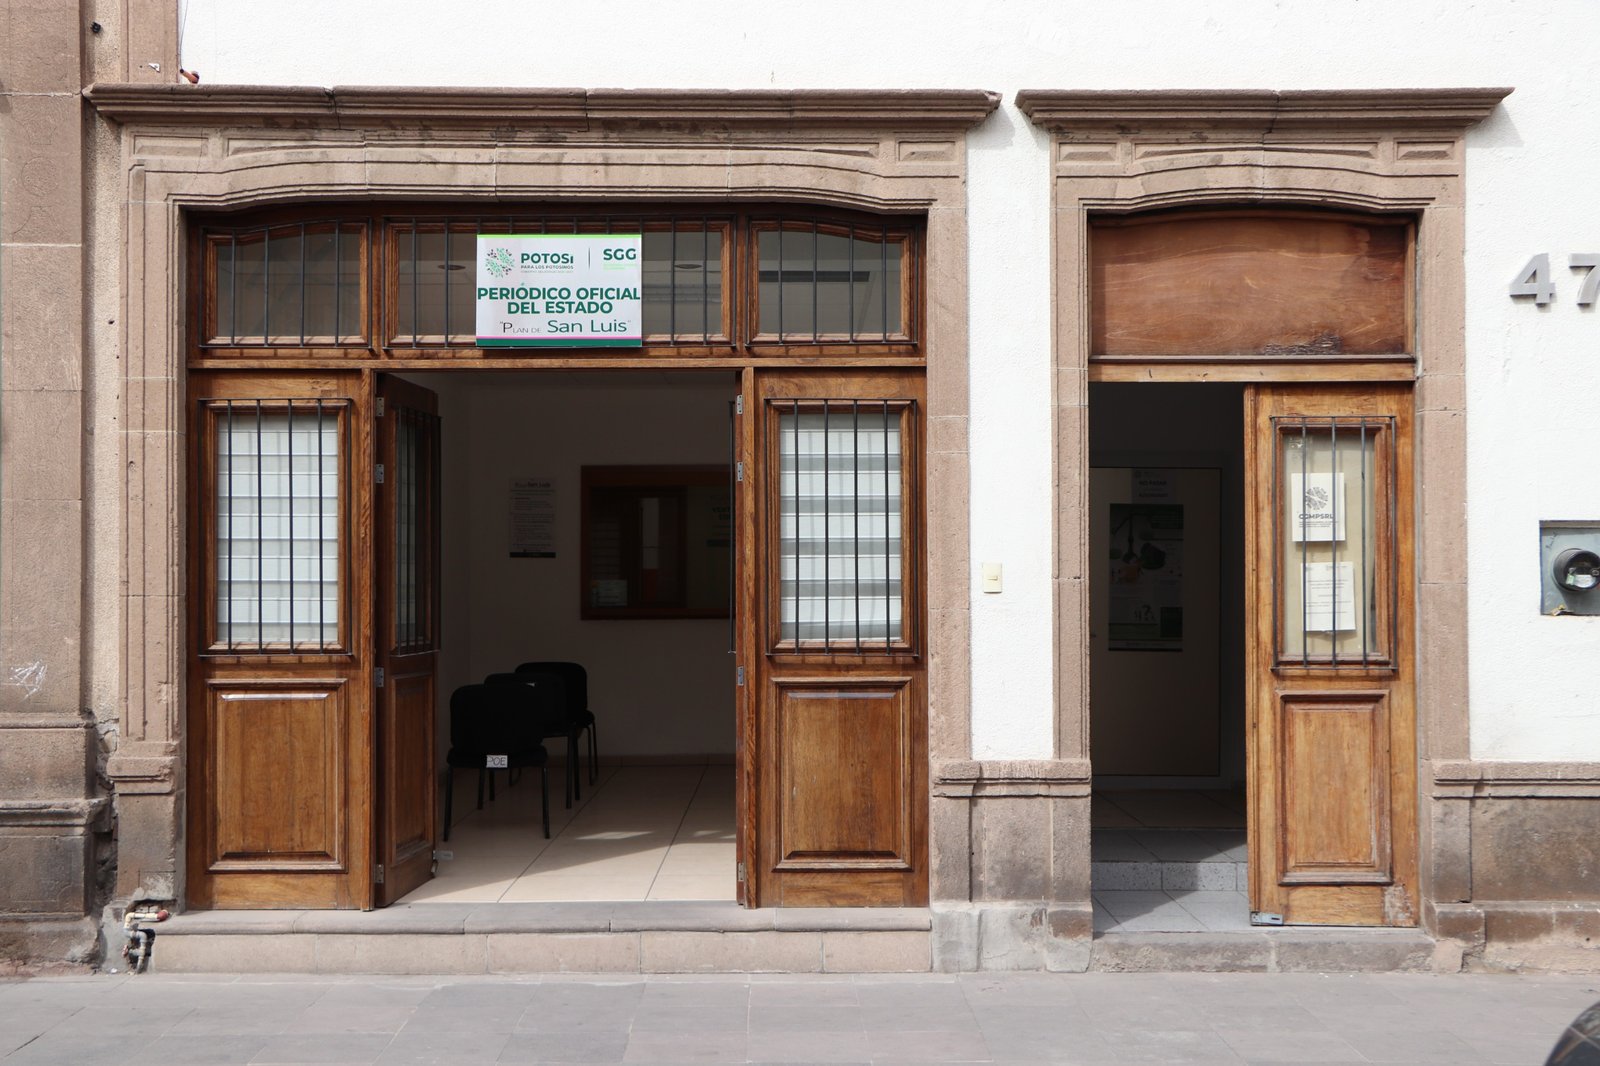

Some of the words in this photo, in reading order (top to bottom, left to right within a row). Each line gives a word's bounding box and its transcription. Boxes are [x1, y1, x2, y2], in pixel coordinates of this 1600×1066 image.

[603, 248, 637, 261] SGG
[477, 282, 571, 300] PERIÓDICO
[576, 287, 641, 300] OFICIAL
[507, 302, 540, 314] DEL
[545, 301, 613, 314] ESTADO
[547, 320, 583, 333] San
